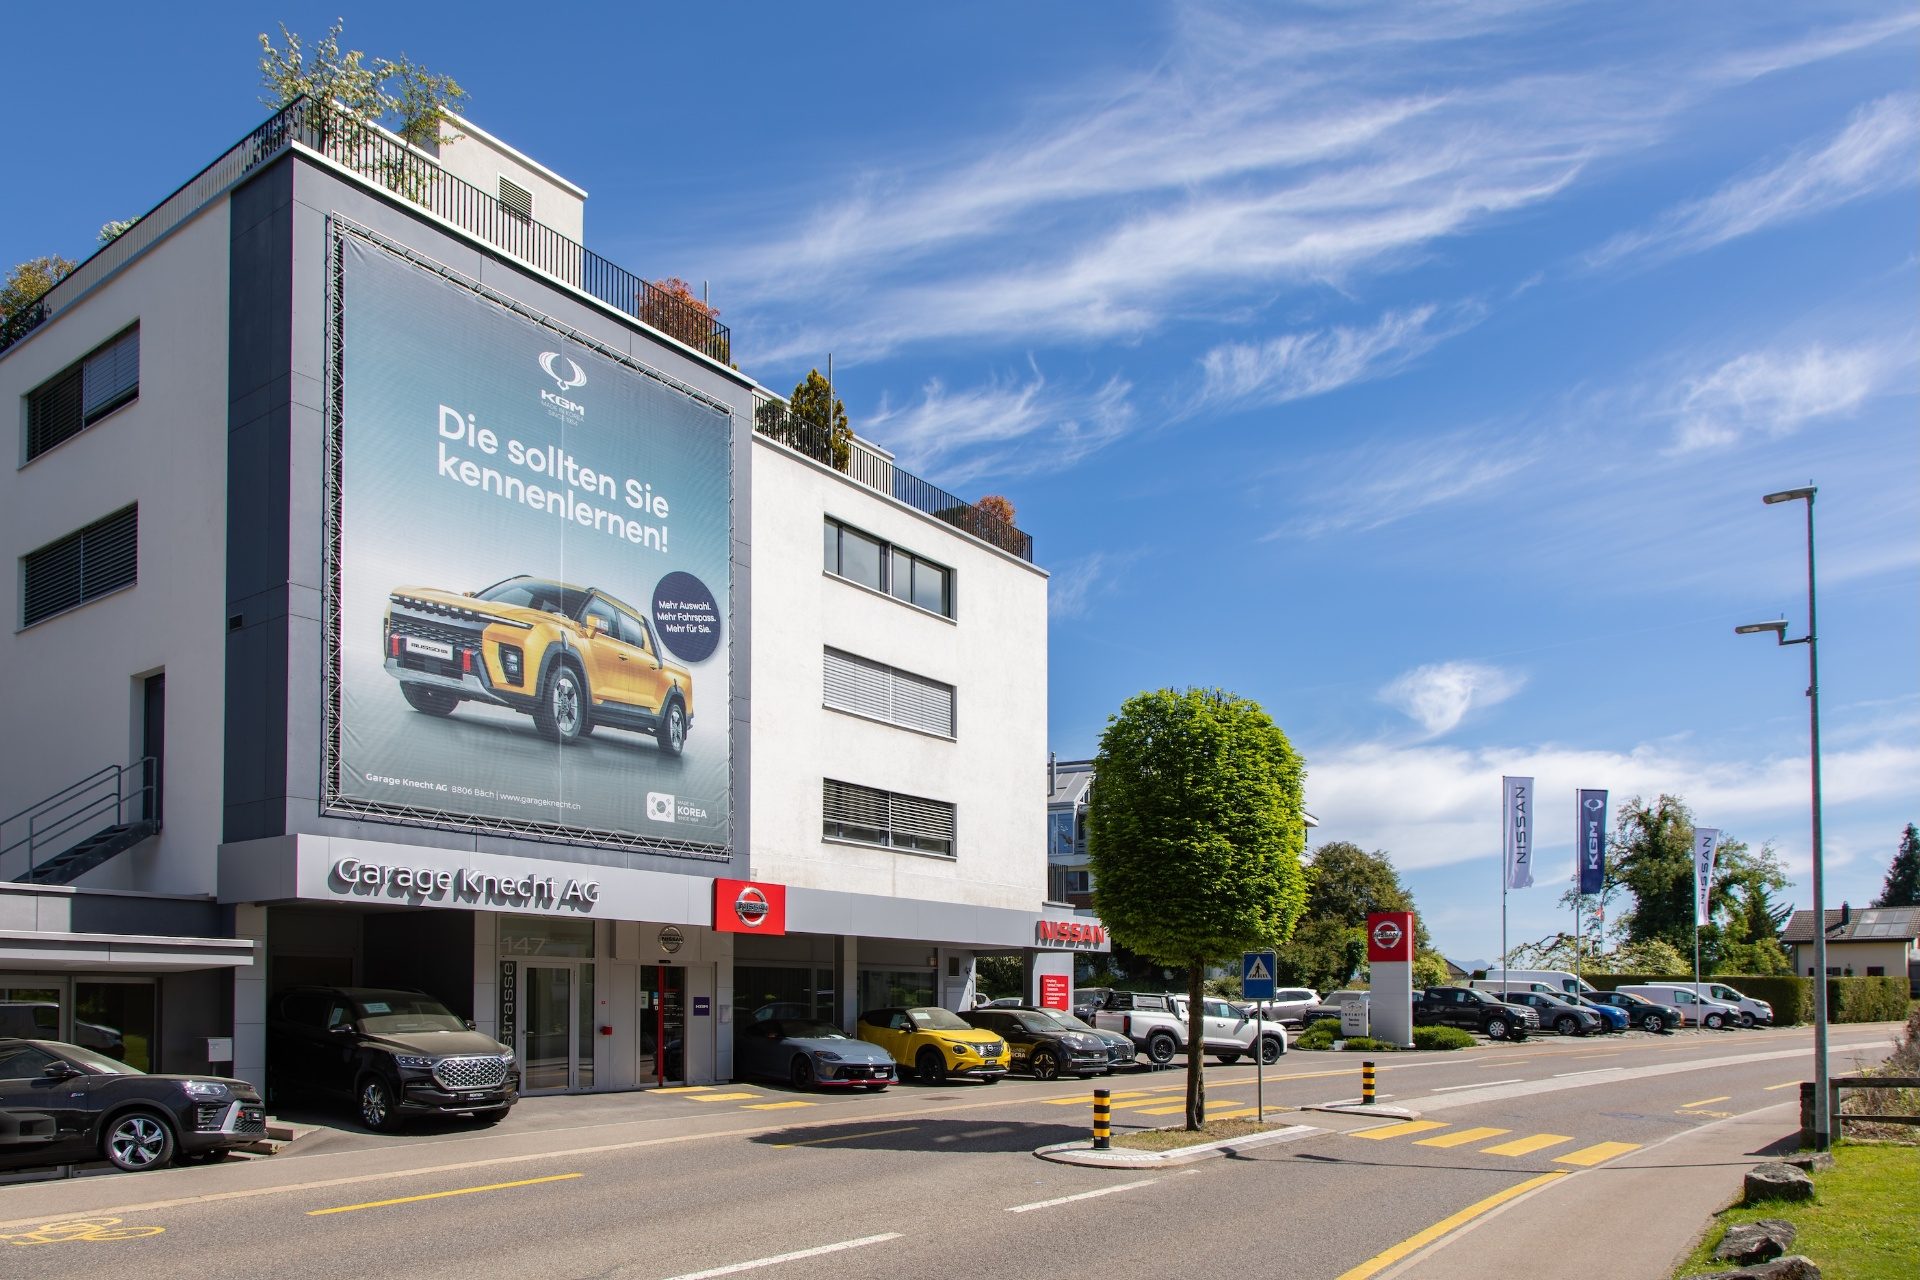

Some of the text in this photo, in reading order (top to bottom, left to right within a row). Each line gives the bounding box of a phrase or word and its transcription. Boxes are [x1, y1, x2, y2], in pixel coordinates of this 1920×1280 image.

[541, 389, 585, 416] KGM
[439, 404, 669, 519] Die sollten Sie
[438, 441, 668, 553] kennenlernen!
[656, 612, 717, 623] Mehr Fahrspass.
[658, 600, 712, 611] Mehr Auswahl.
[666, 624, 712, 633] Mehr für Sie.
[365, 773, 401, 786] Garage
[402, 778, 434, 790] Knecht
[435, 783, 448, 792] AG
[451, 786, 473, 795] 8806
[474, 788, 495, 797] Bäch
[500, 793, 581, 811] www.garageknecht.ch
[677, 806, 708, 818] KOREA
[1515, 786, 1527, 864] NISSAN
[1588, 820, 1599, 870] KGM
[337, 856, 601, 902] Garage Knecht AG
[1701, 836, 1711, 904] NISSAN
[736, 902, 768, 913] NISSAN
[1040, 920, 1105, 944] NISSAN
[1374, 930, 1400, 939] NISSAN
[501, 936, 546, 954] 147
